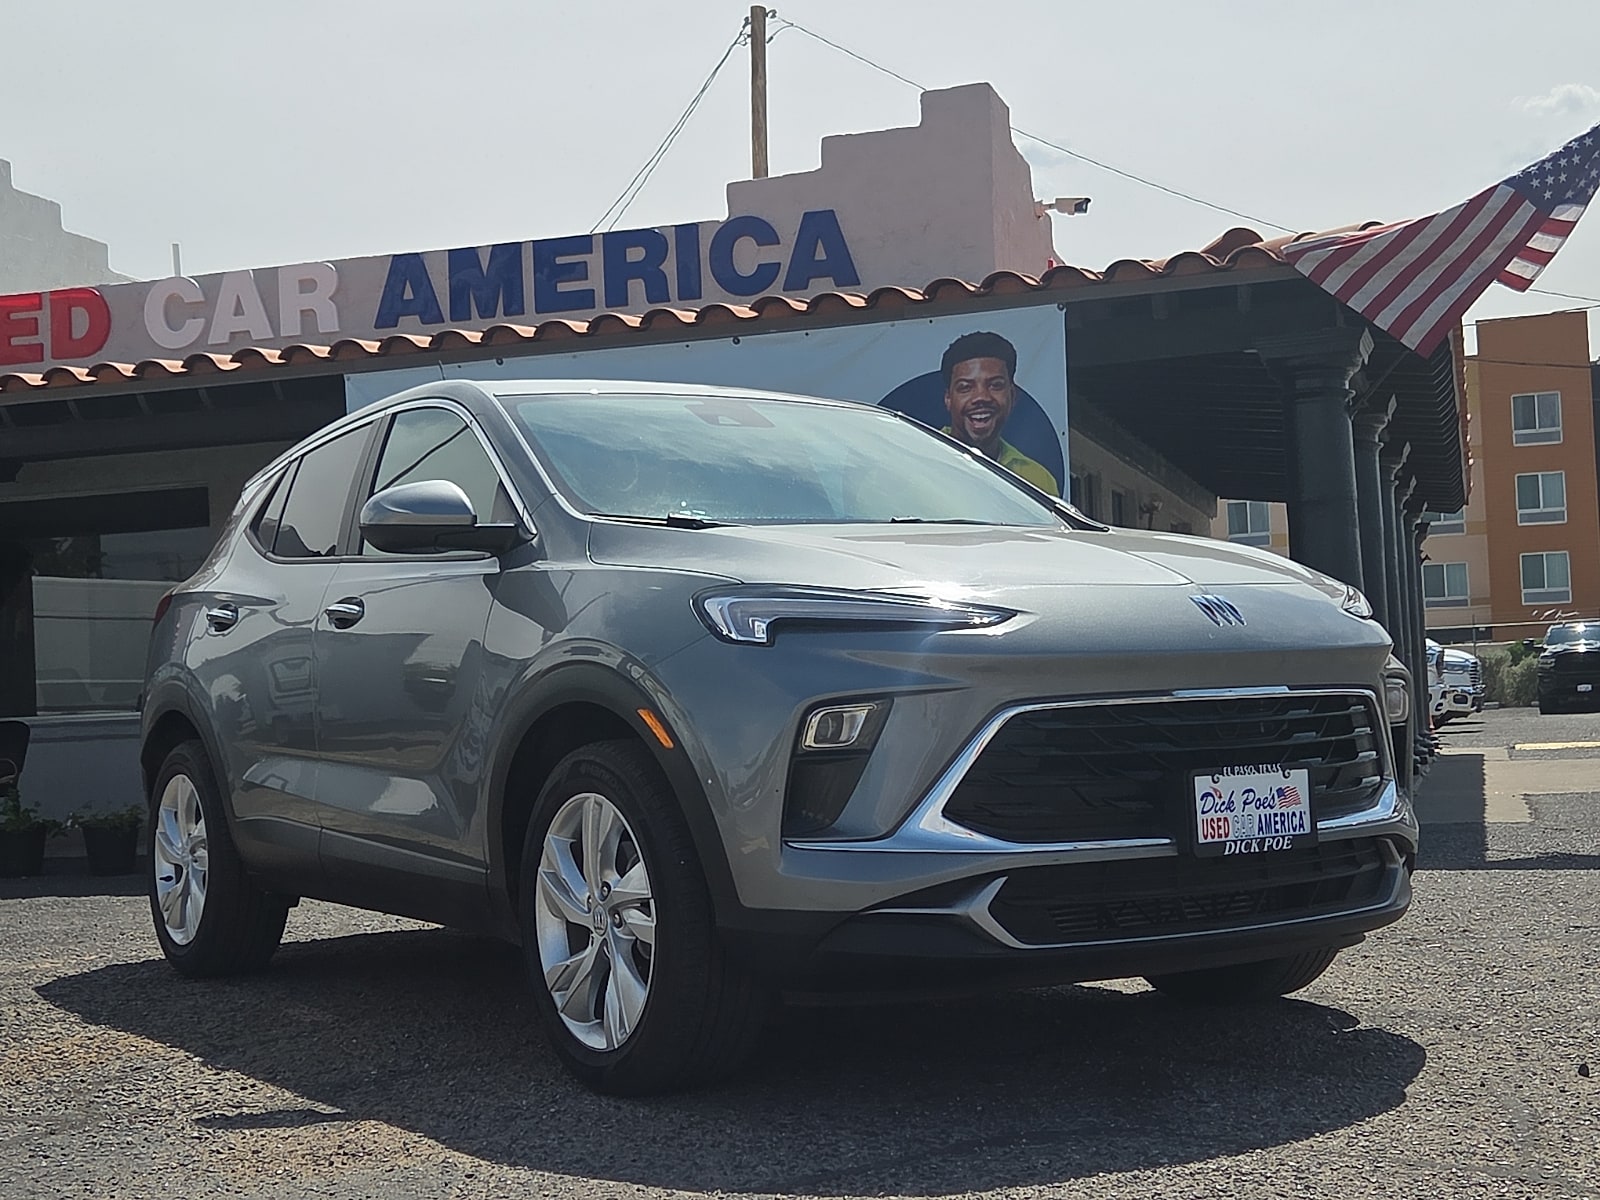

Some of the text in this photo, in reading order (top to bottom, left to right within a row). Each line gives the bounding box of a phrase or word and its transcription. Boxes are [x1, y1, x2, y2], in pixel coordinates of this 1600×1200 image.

[0, 210, 861, 365] ED CAR AMERICA
[1223, 766, 1231, 777] EL
[1258, 763, 1281, 775] TEXAS
[1200, 786, 1276, 814] Dick Poe's
[1202, 810, 1306, 840] USED CAR AMERICA
[1224, 835, 1293, 856] DICK POE
